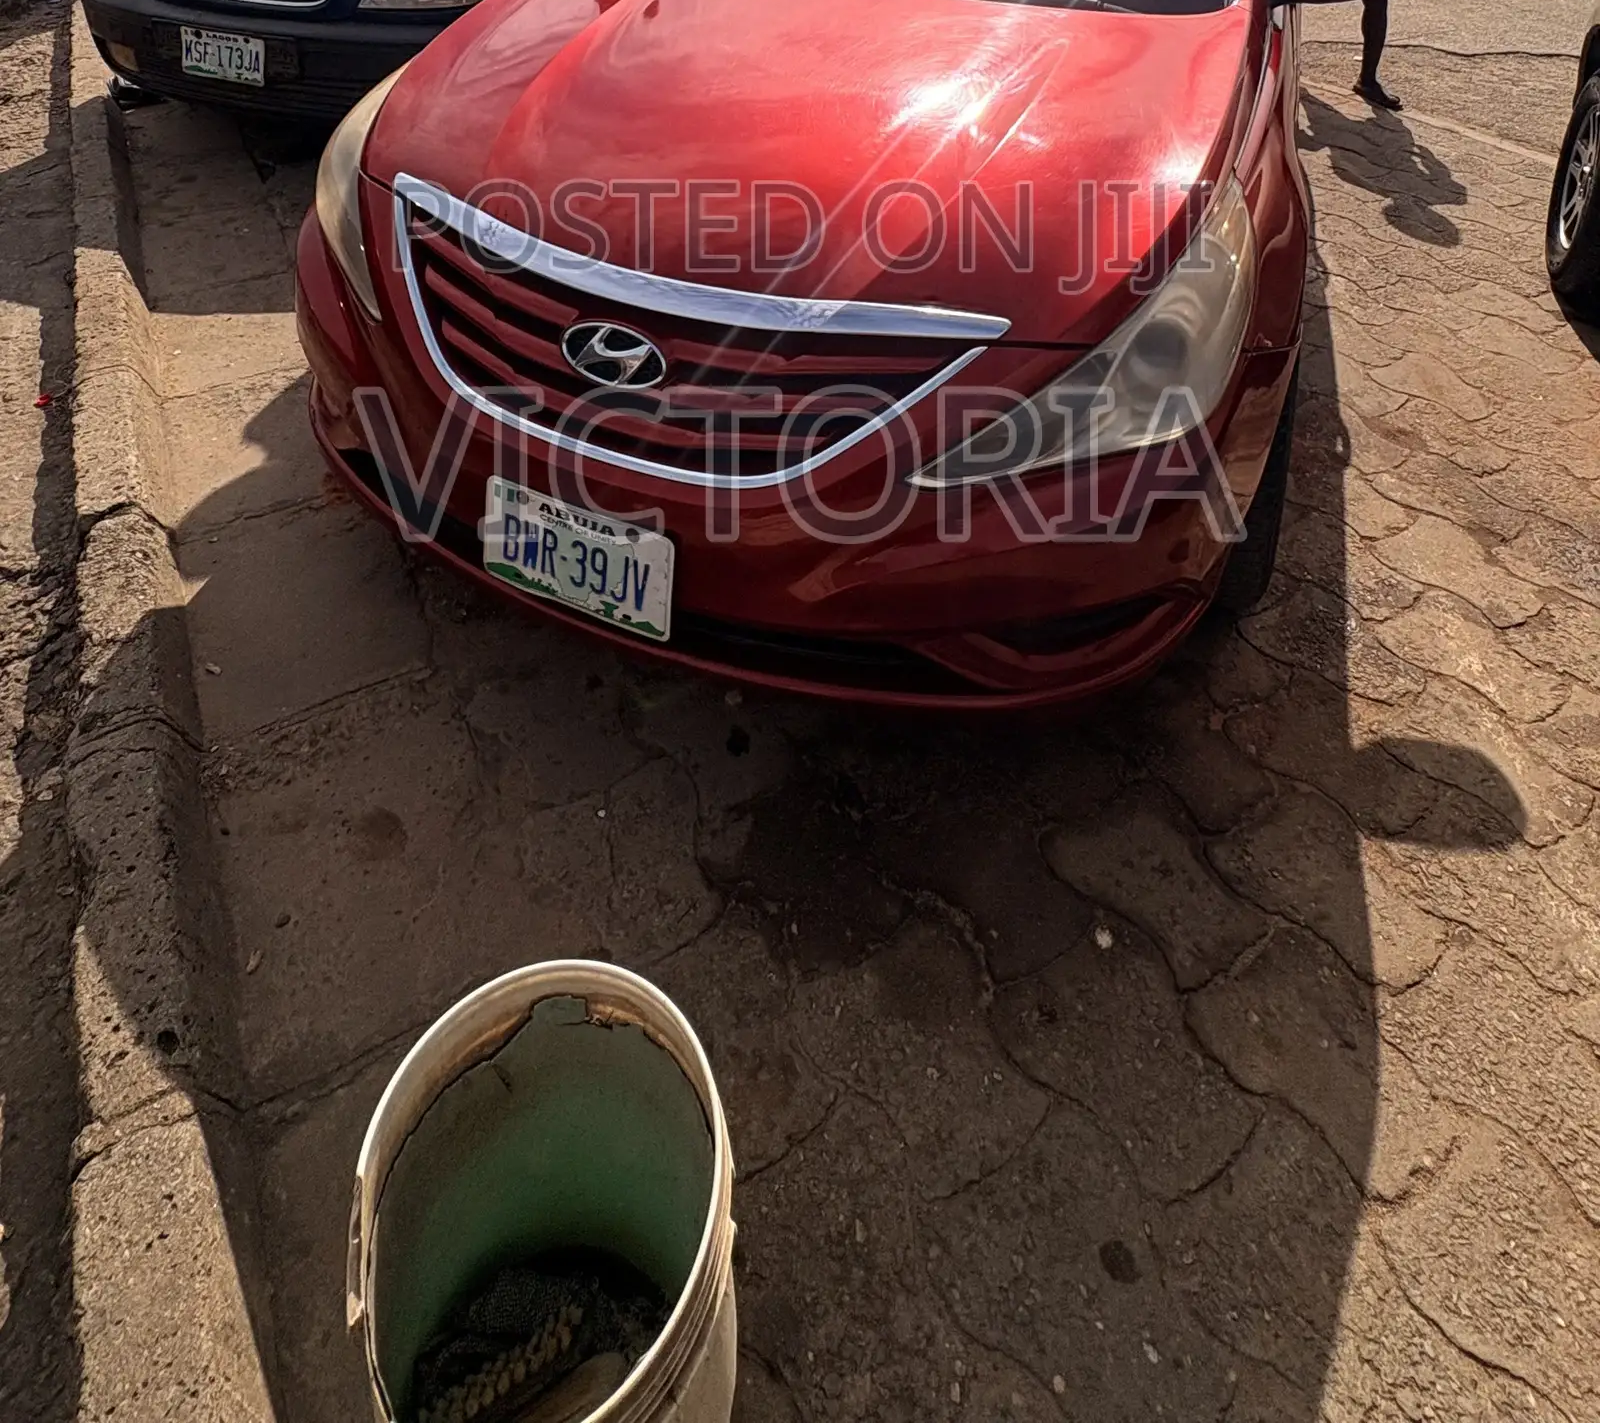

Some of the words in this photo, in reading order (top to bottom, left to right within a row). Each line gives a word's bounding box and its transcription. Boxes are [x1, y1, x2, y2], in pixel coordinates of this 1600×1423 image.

[538, 502, 616, 537] ABUJA
[539, 514, 573, 532] CENTRE
[575, 526, 590, 537] OF
[590, 533, 617, 545] UNITY
